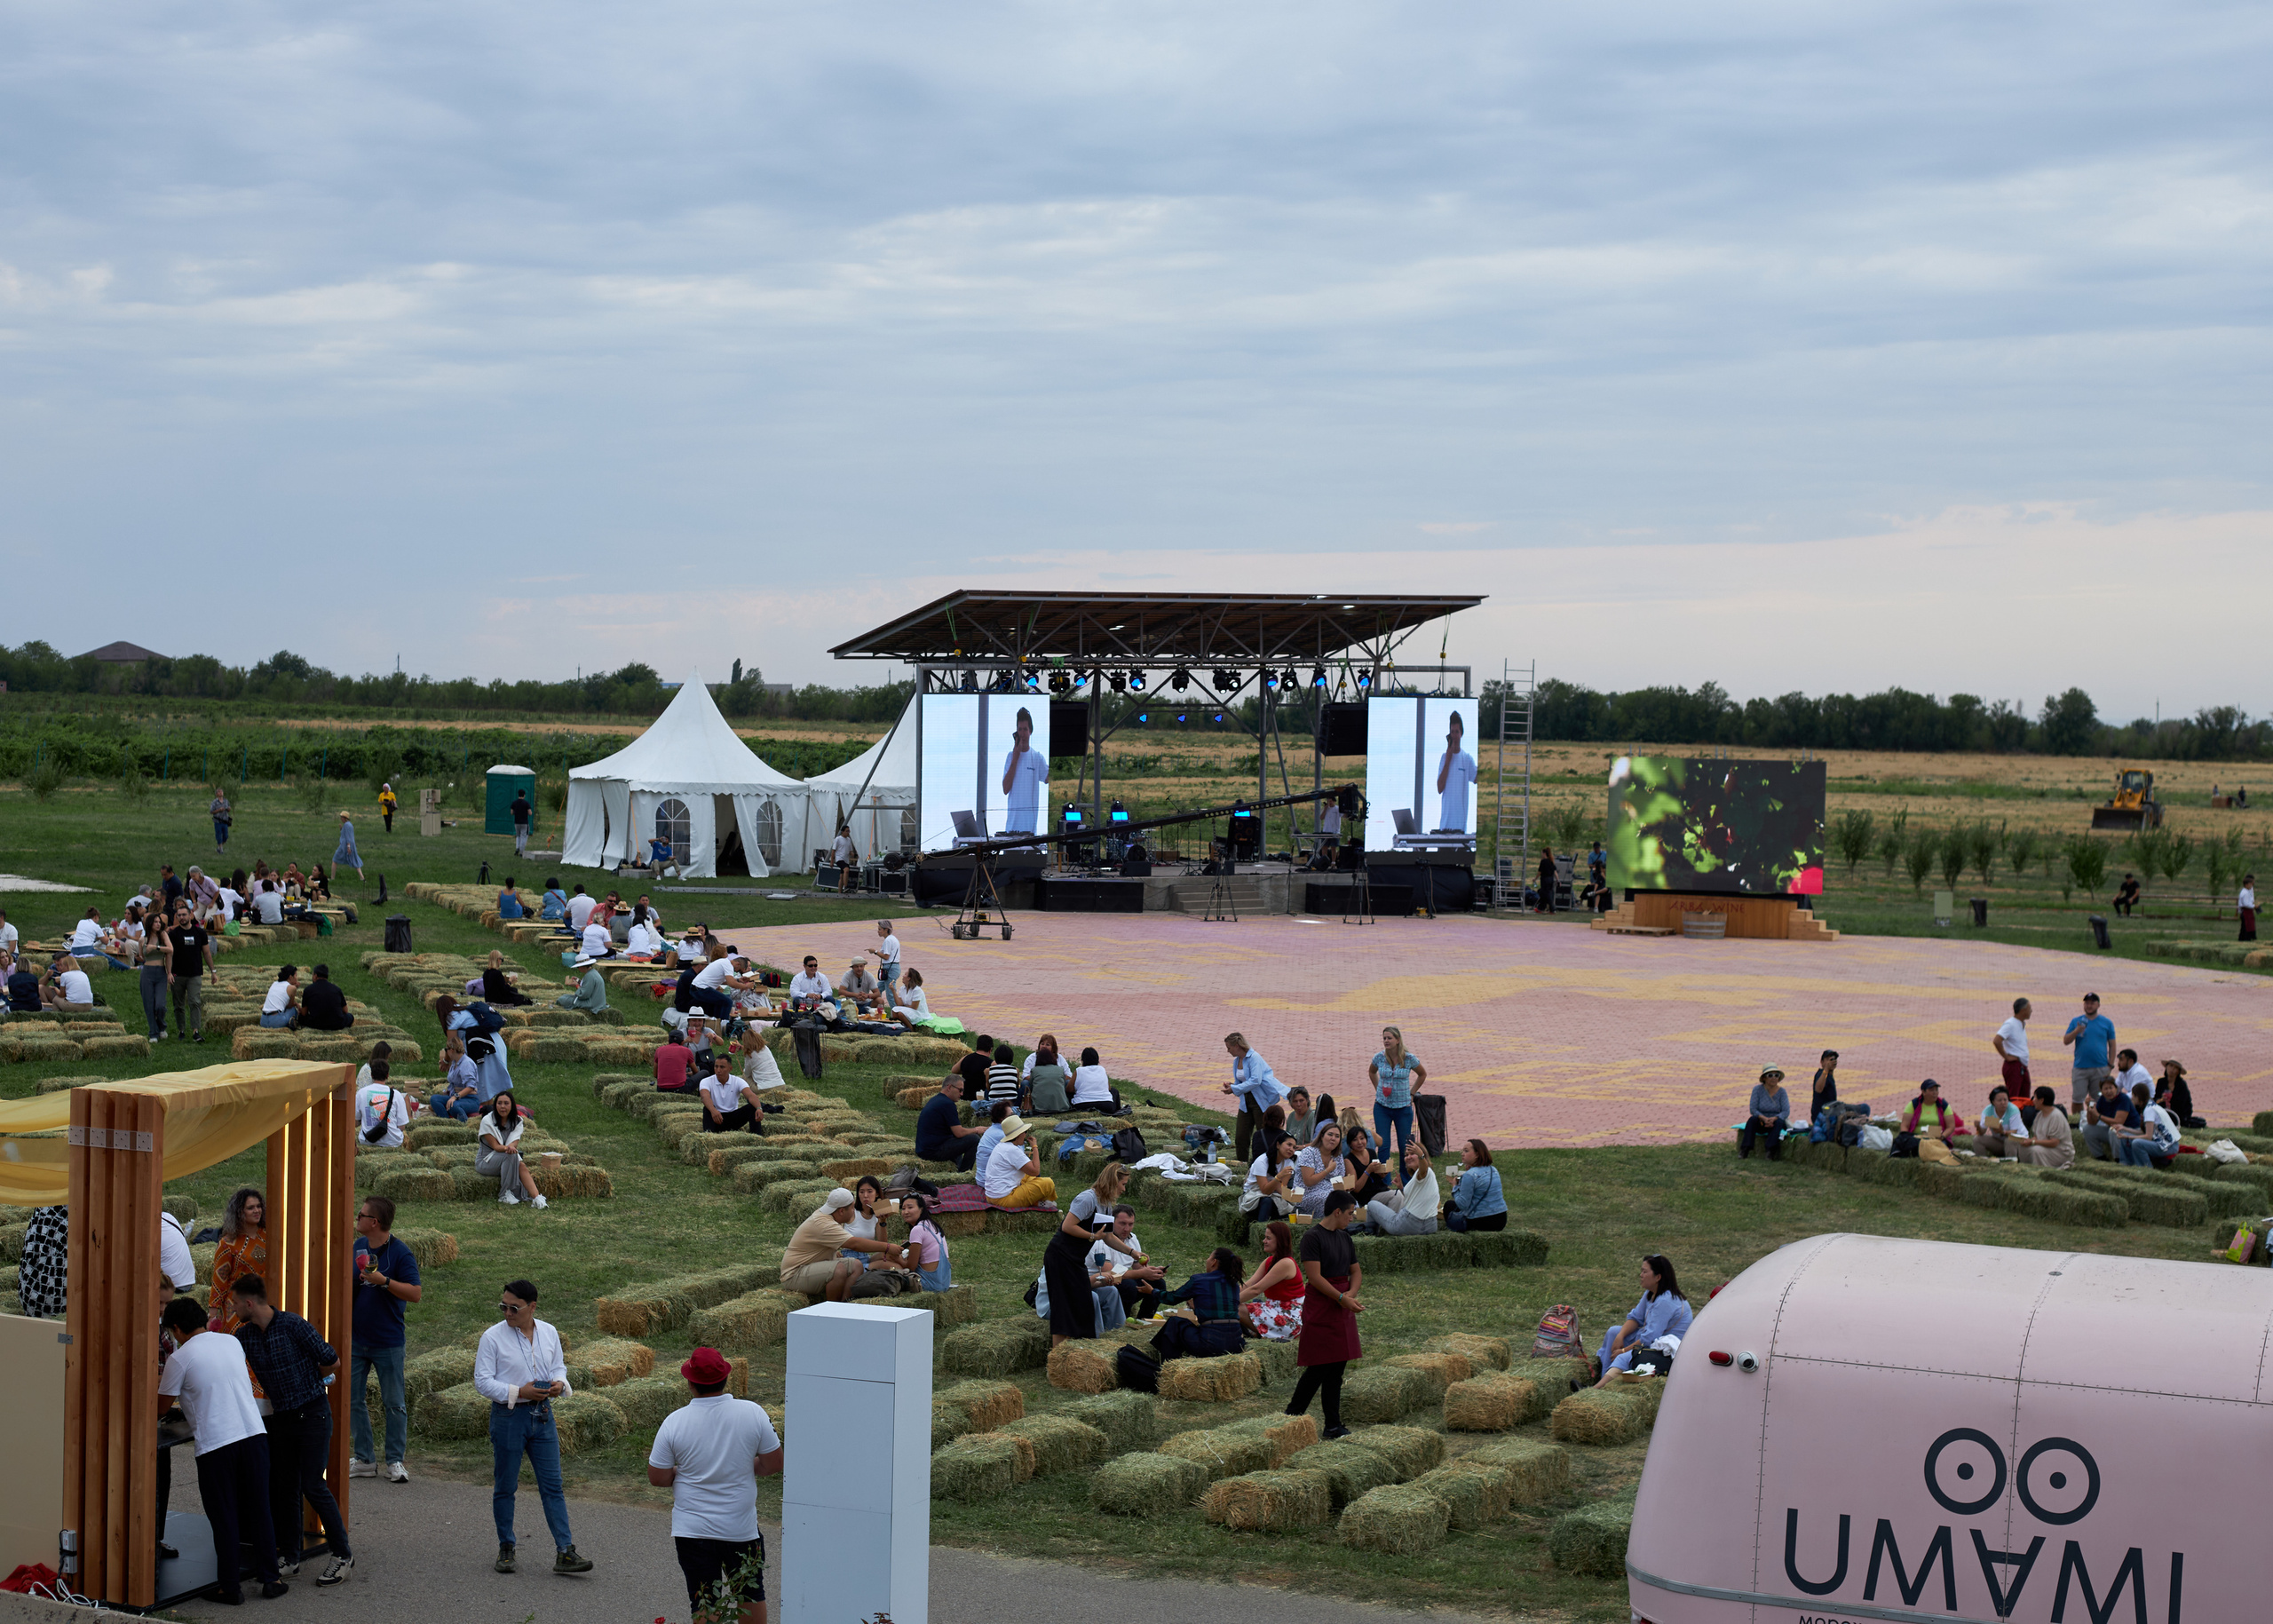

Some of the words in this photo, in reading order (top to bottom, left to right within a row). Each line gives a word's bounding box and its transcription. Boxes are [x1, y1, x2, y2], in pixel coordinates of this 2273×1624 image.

[1669, 900, 1705, 912] ARBA
[1712, 902, 1746, 914] WINE
[1784, 1508, 2184, 1624] UMAMI
